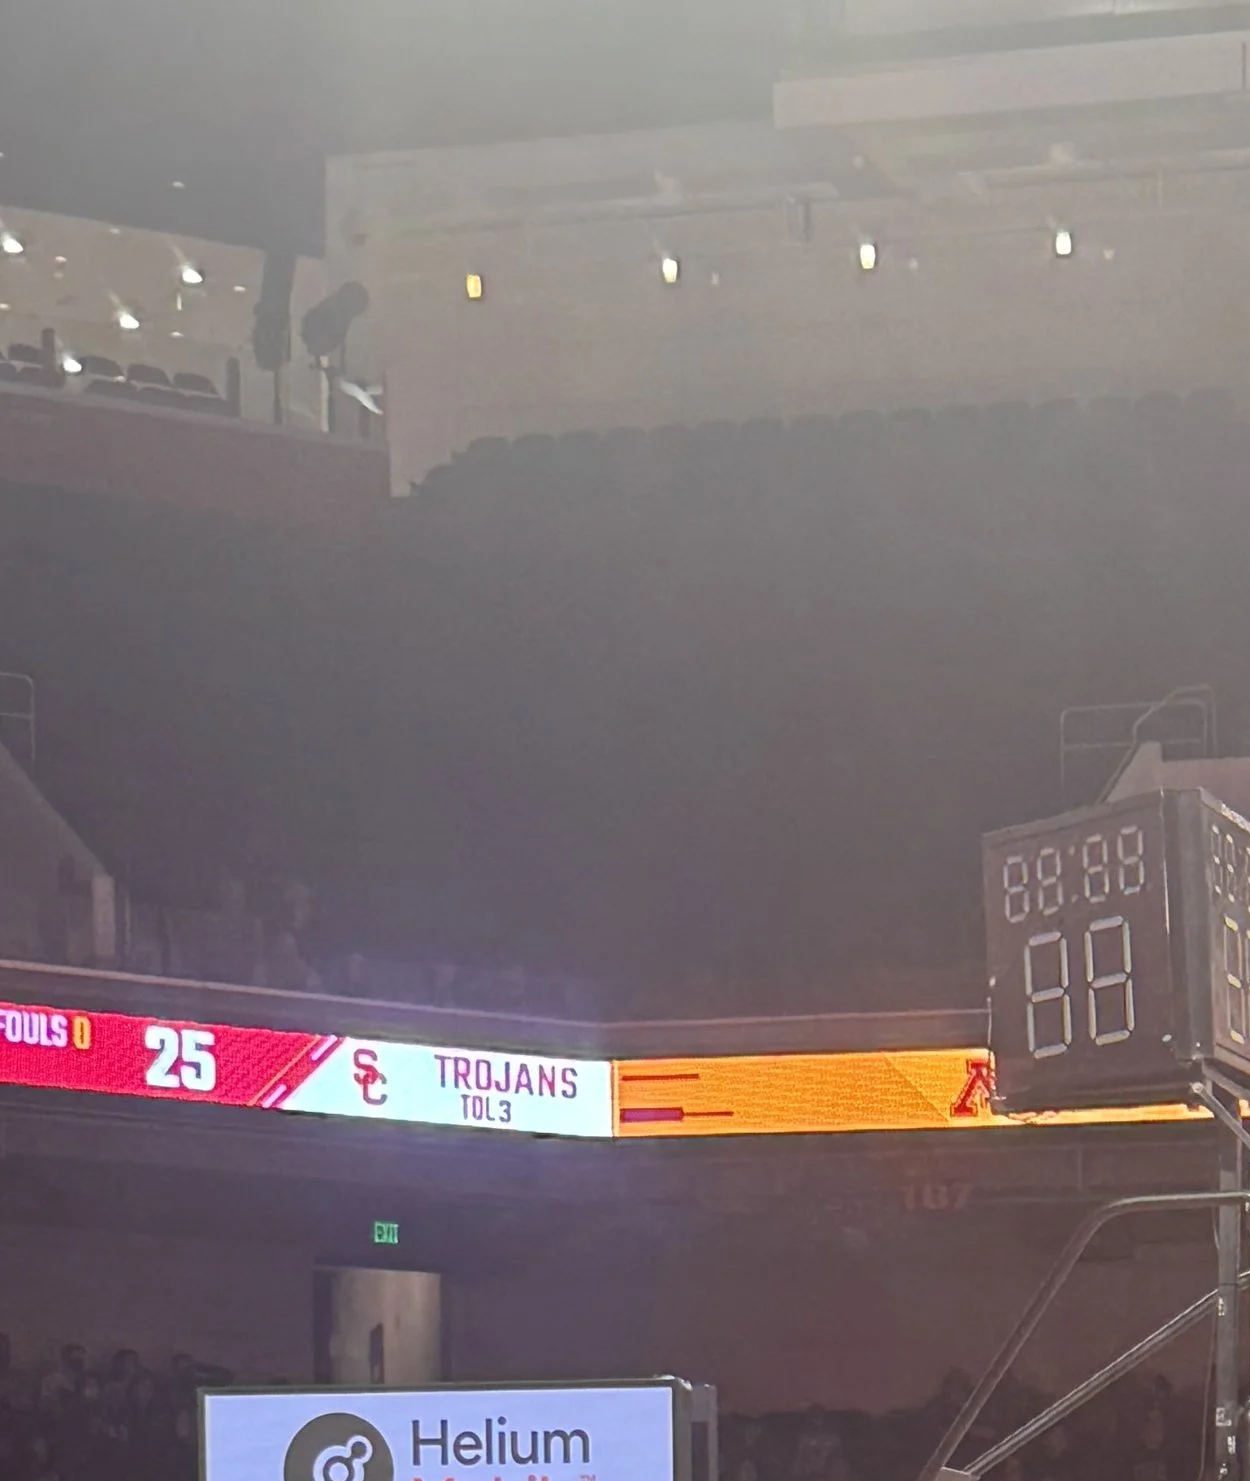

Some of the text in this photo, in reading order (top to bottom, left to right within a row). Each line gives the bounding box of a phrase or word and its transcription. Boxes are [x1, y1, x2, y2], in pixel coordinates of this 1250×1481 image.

[144, 1025, 217, 1092] 25
[353, 1048, 388, 1106] SC
[434, 1054, 578, 1099] TROJANS
[411, 1416, 591, 1467] Helium
